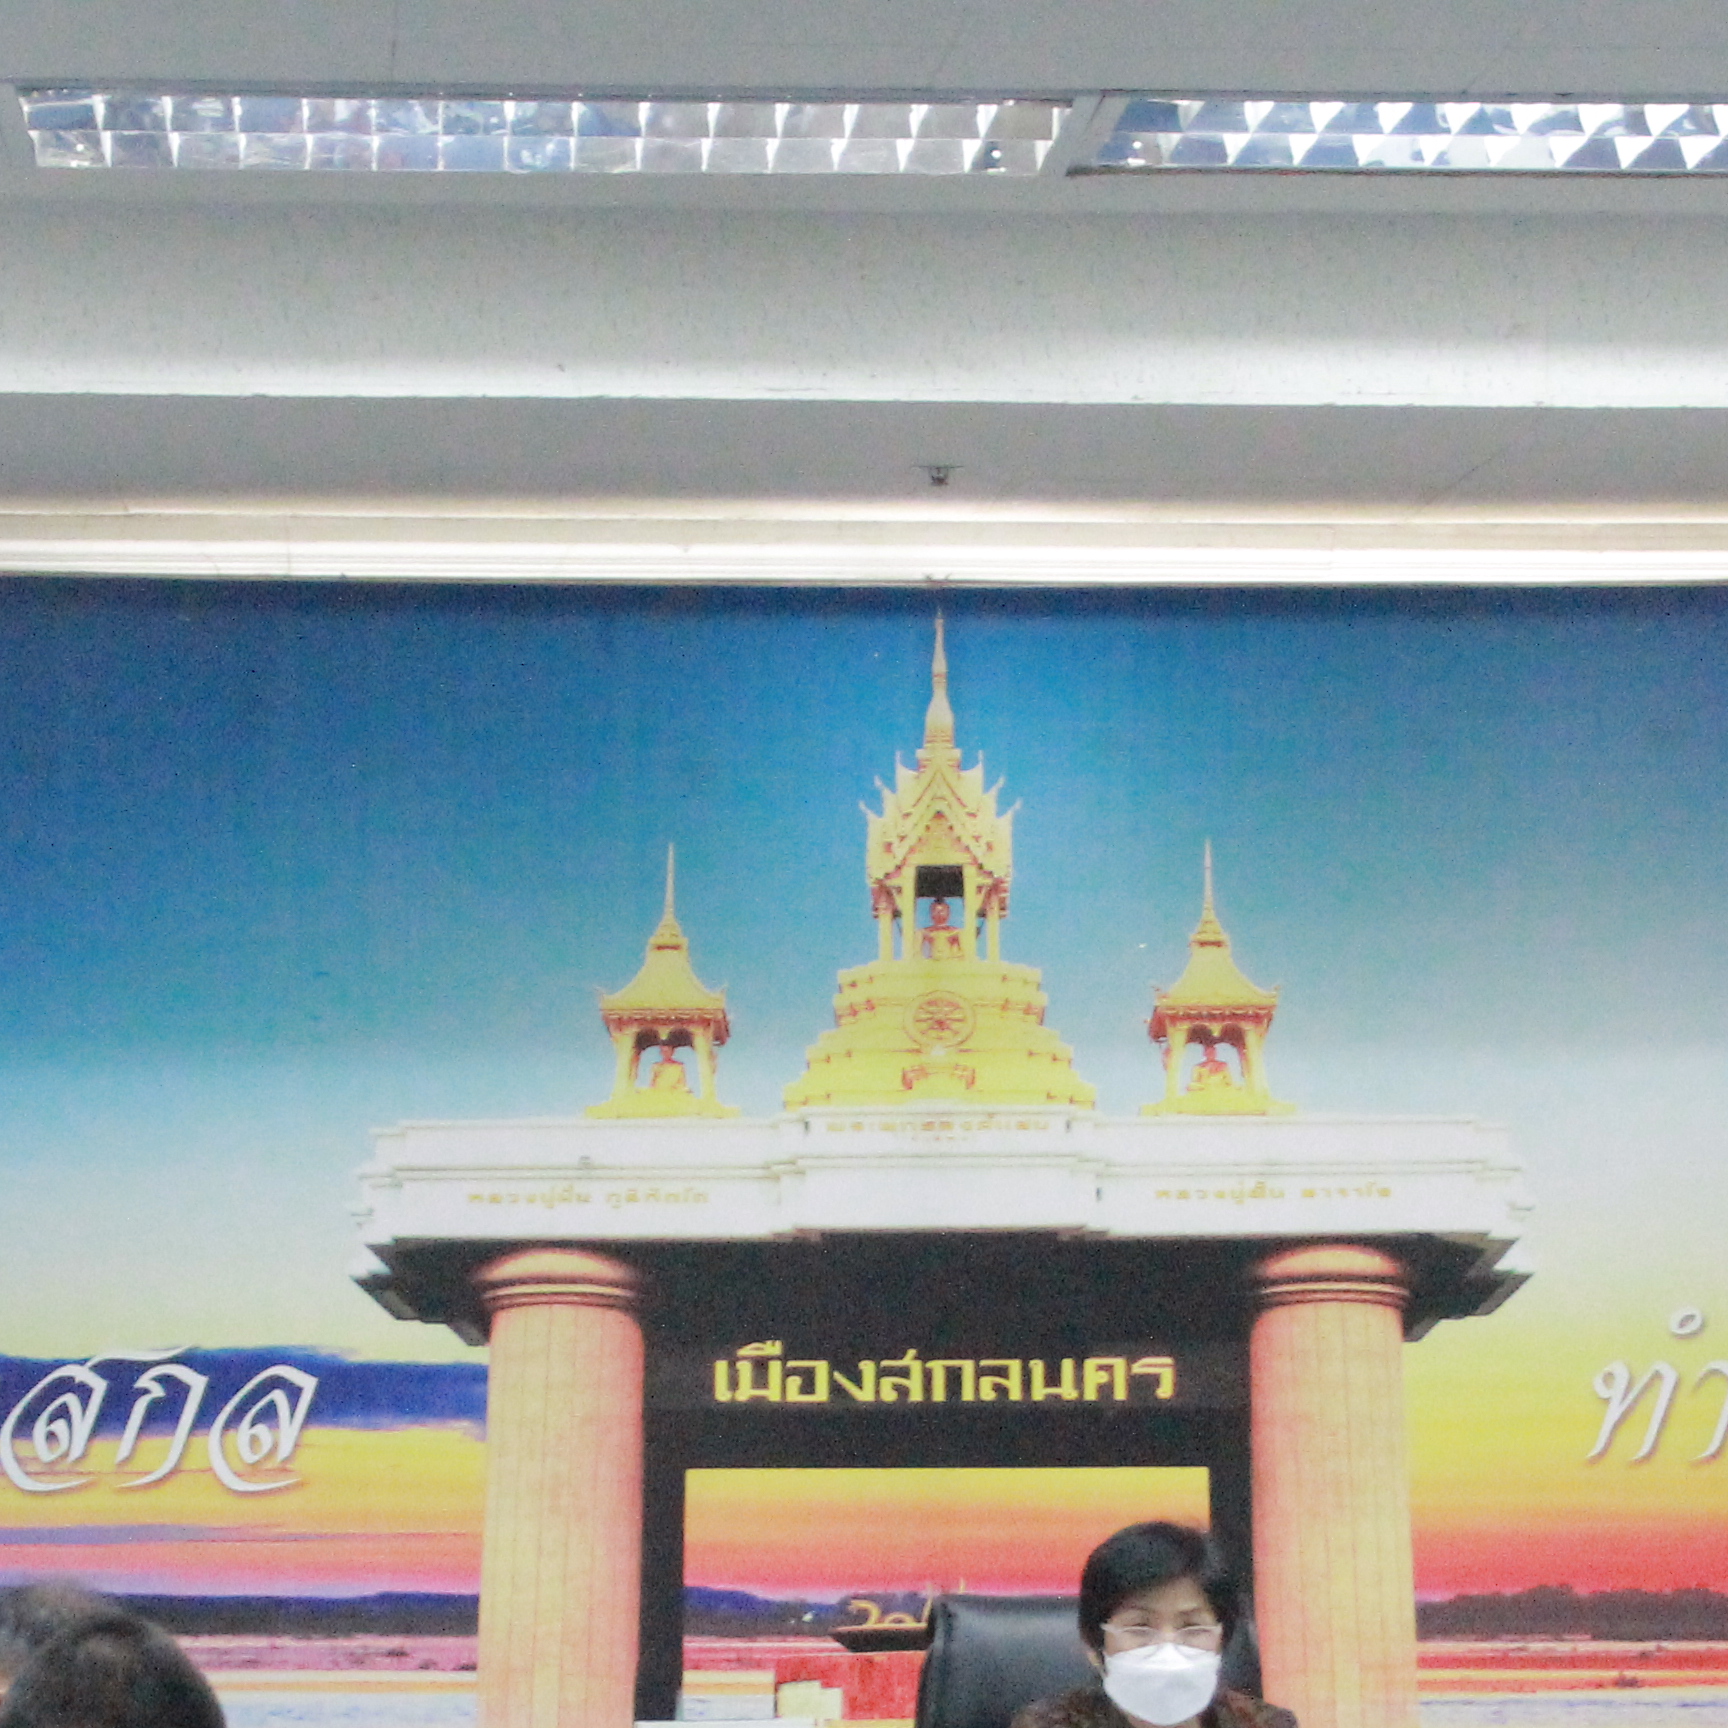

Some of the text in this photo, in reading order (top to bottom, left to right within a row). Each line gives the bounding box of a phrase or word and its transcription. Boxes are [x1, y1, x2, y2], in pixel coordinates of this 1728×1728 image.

[712, 1340, 1176, 1405] เมืองสกลนคร
